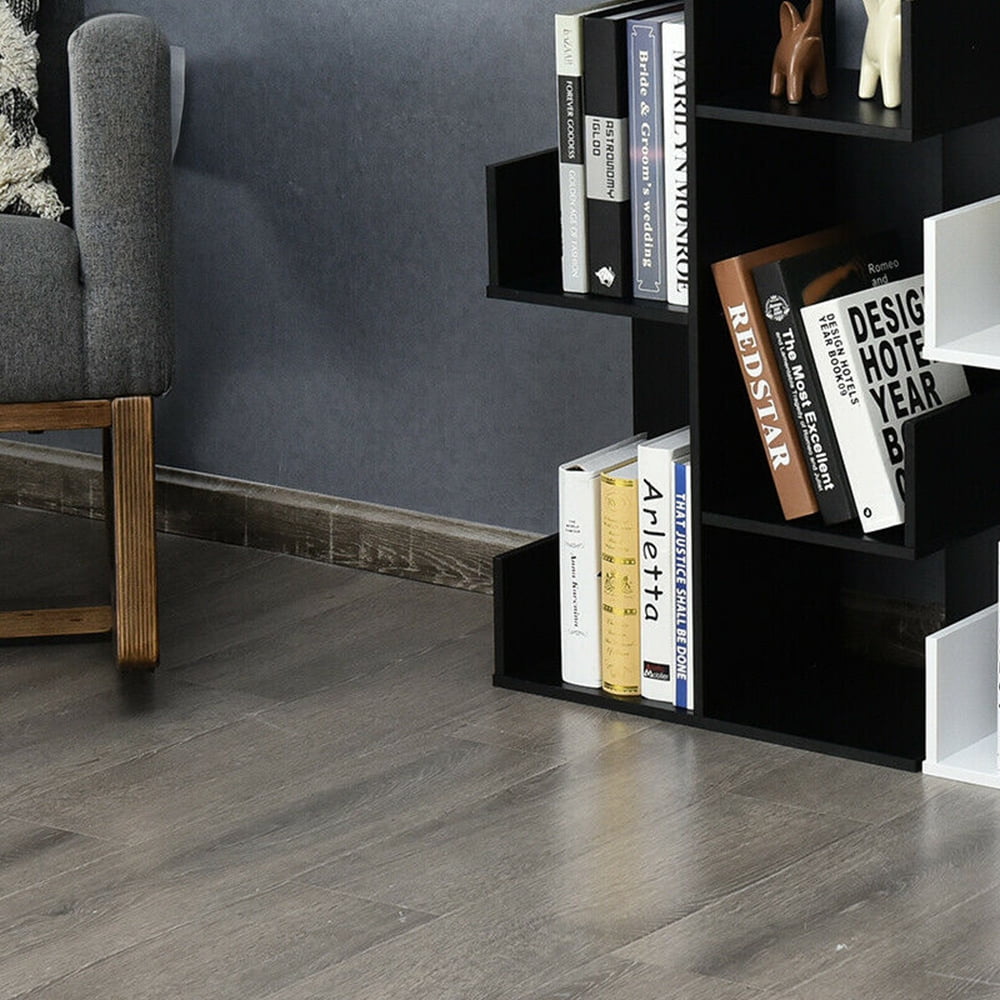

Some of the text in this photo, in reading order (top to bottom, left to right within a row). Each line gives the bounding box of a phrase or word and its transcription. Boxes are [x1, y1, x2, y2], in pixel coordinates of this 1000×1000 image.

[565, 80, 576, 160] FOREVER GODDESS
[592, 118, 601, 157] IGLOO
[605, 119, 615, 199] ASTRONOMY
[639, 49, 654, 269] Bride & Groom's wedding
[674, 178, 690, 293] MONROE
[867, 257, 900, 275] Romeo
[847, 285, 925, 344] DESIG
[870, 273, 889, 287] and
[817, 315, 833, 347] YEAR
[827, 312, 860, 406] DESIGN HOTELS
[858, 329, 937, 385] HOTE
[782, 327, 836, 492] The Most Excellent
[868, 370, 943, 424] YEAR
[791, 389, 804, 420] Tragedy
[814, 471, 824, 493] Juliet
[642, 477, 666, 622] Arletta
[674, 491, 688, 681] THAT JUSTICE SHALL BE DONE
